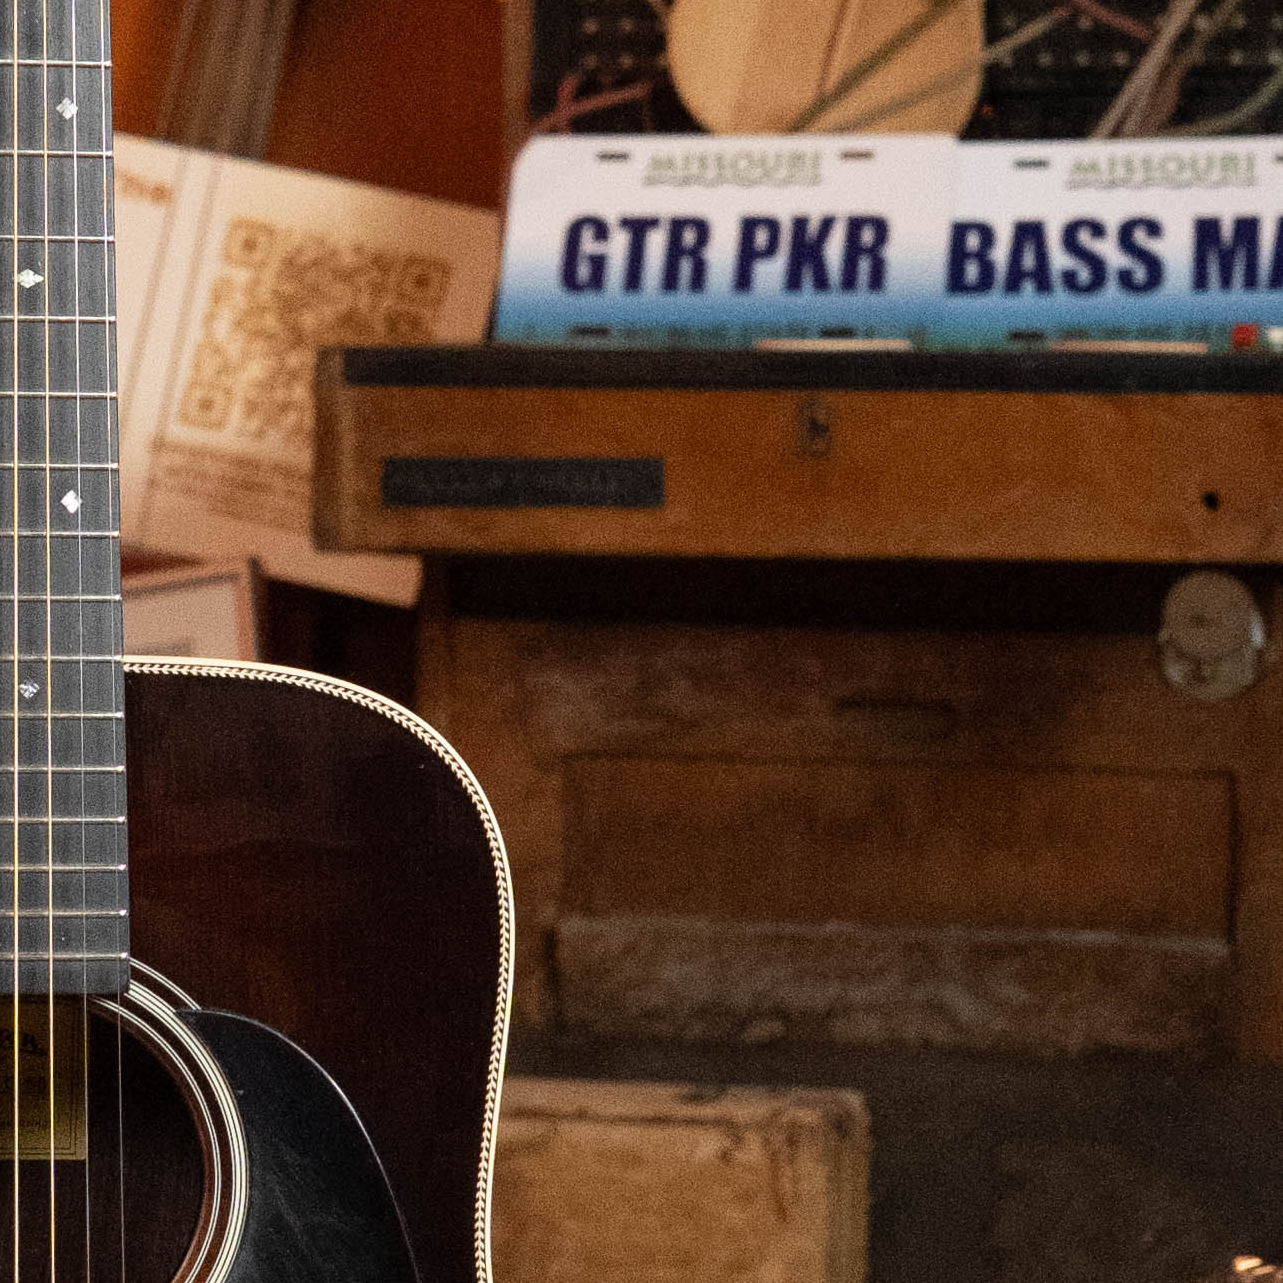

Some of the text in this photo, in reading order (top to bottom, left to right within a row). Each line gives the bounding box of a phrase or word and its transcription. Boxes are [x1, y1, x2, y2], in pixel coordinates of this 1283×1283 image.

[644, 151, 821, 182] MISSOURI
[1071, 153, 1256, 184] MISSOURI
[558, 215, 891, 295] GTR PKR
[946, 217, 1165, 296] BASS
